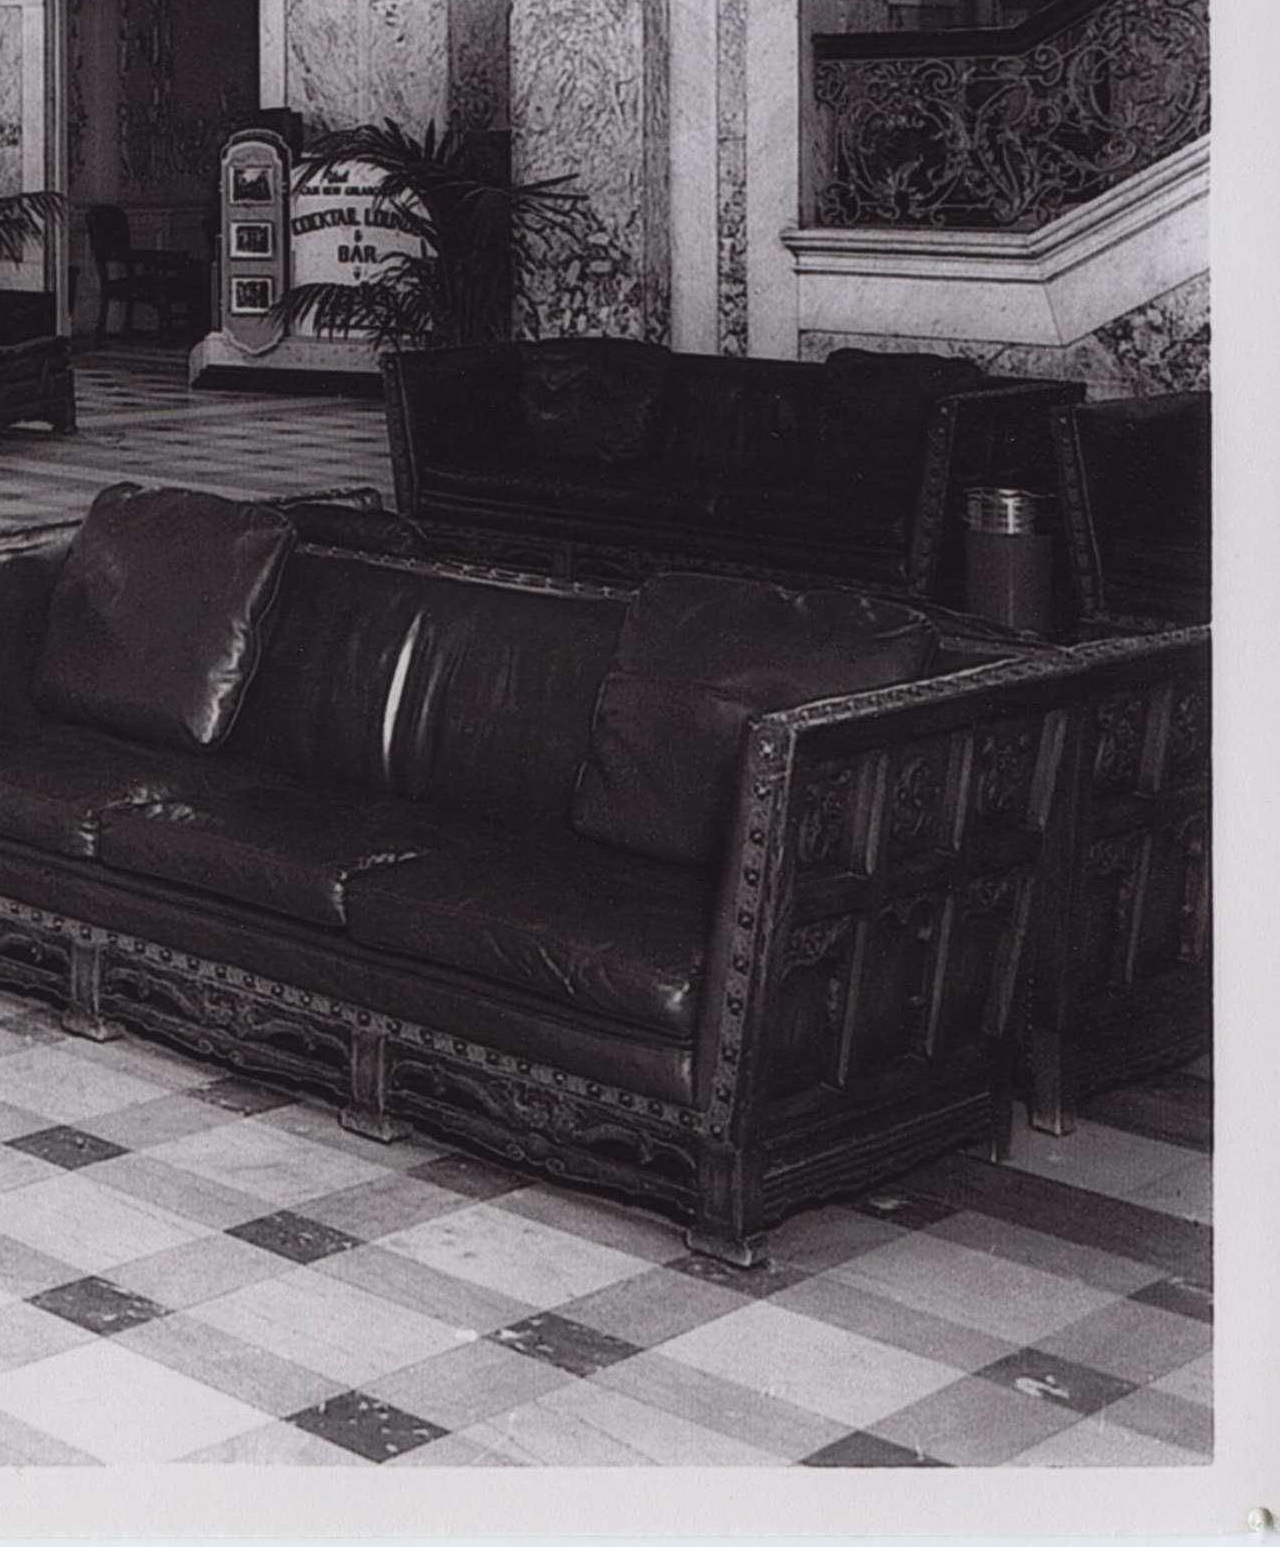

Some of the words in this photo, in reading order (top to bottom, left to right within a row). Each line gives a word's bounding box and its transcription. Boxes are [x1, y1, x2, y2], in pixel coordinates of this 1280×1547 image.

[292, 207, 361, 236] COCKTAIL
[364, 208, 418, 236] LOUN
[338, 245, 378, 263] BAR
